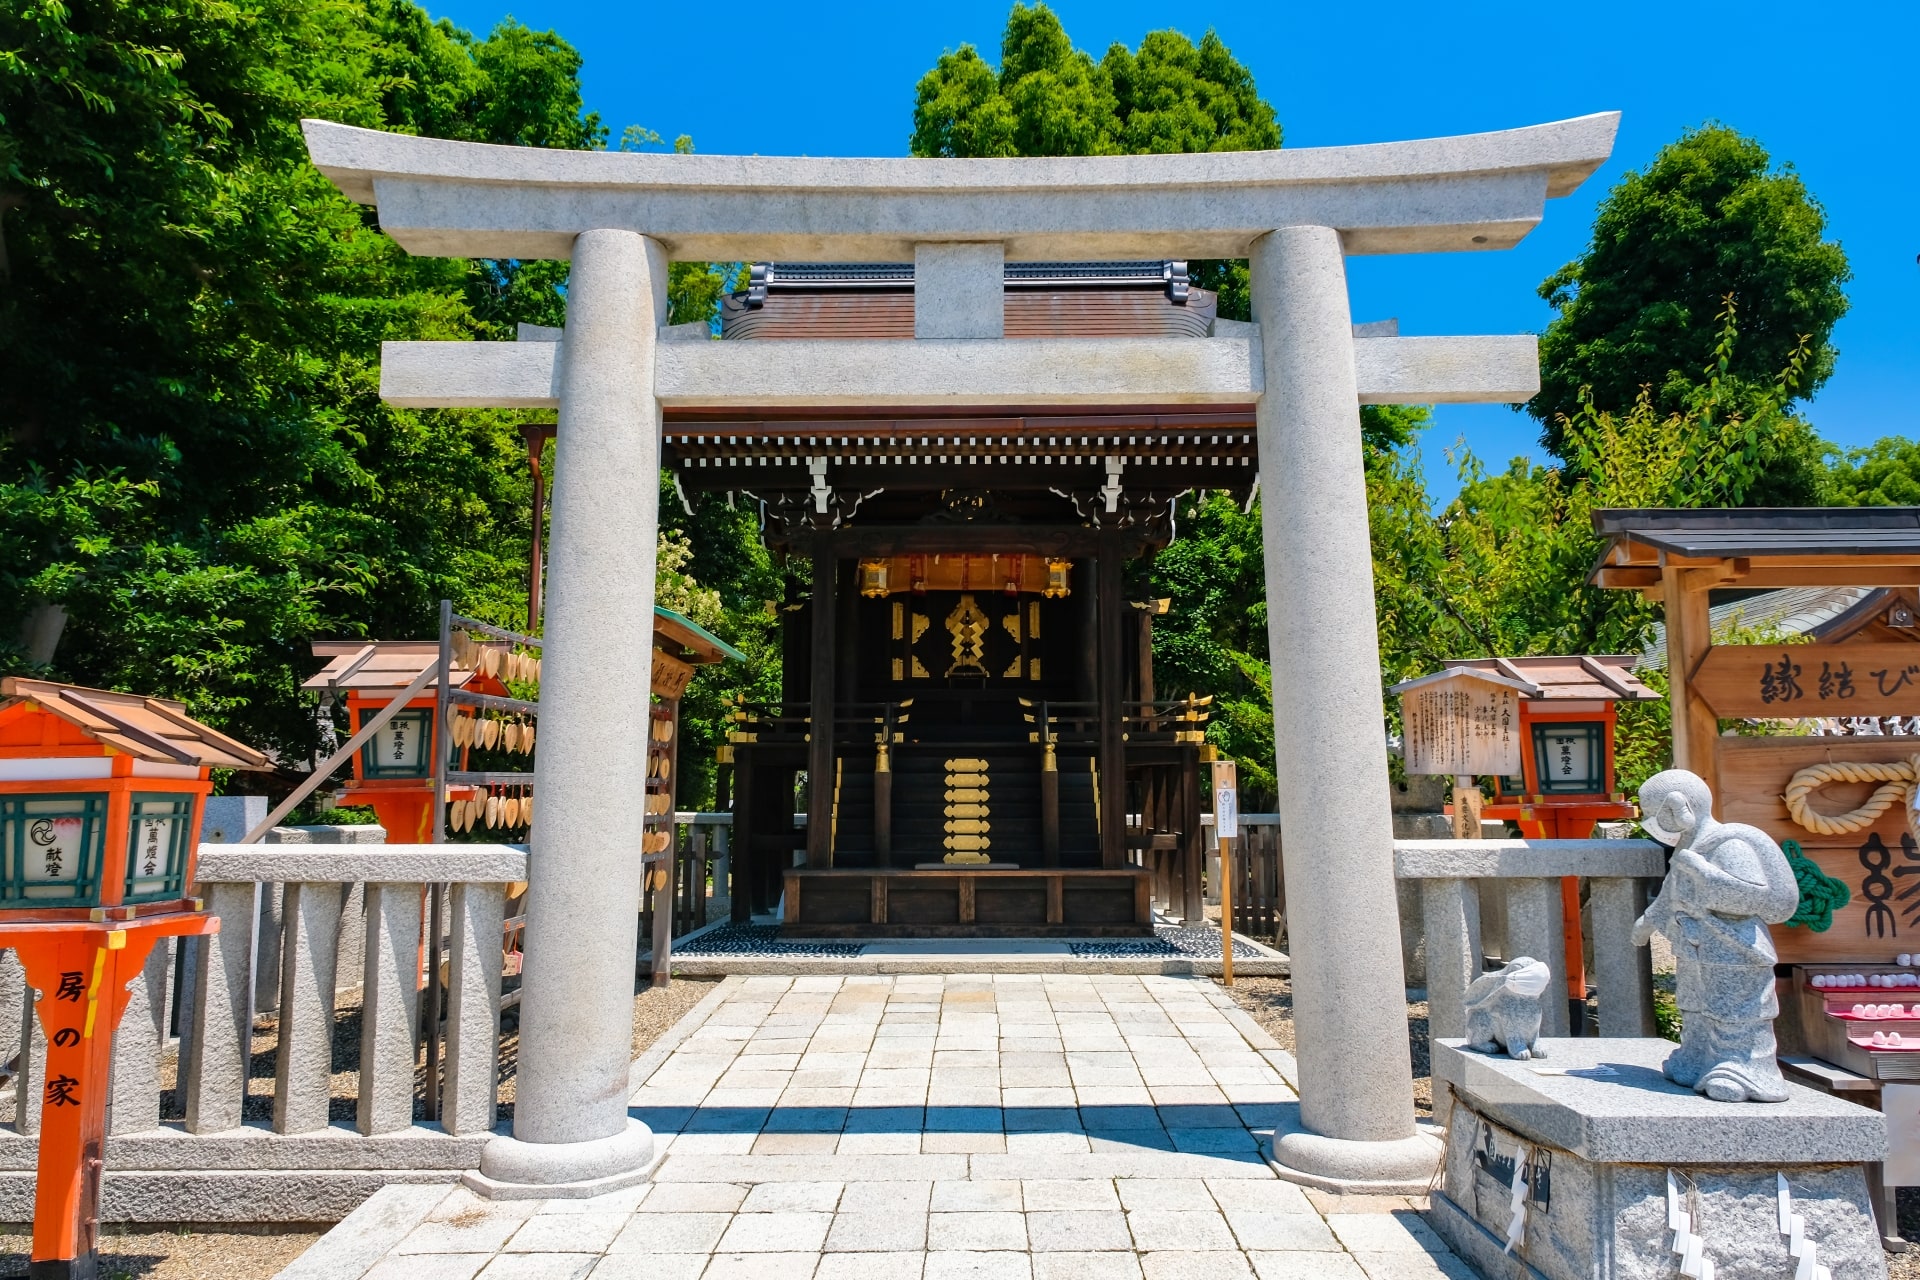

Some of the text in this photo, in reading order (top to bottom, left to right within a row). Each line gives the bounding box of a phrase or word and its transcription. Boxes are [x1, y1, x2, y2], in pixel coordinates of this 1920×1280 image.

[1759, 653, 1920, 704] 縁結び
[46, 971, 86, 1107] 房の家
